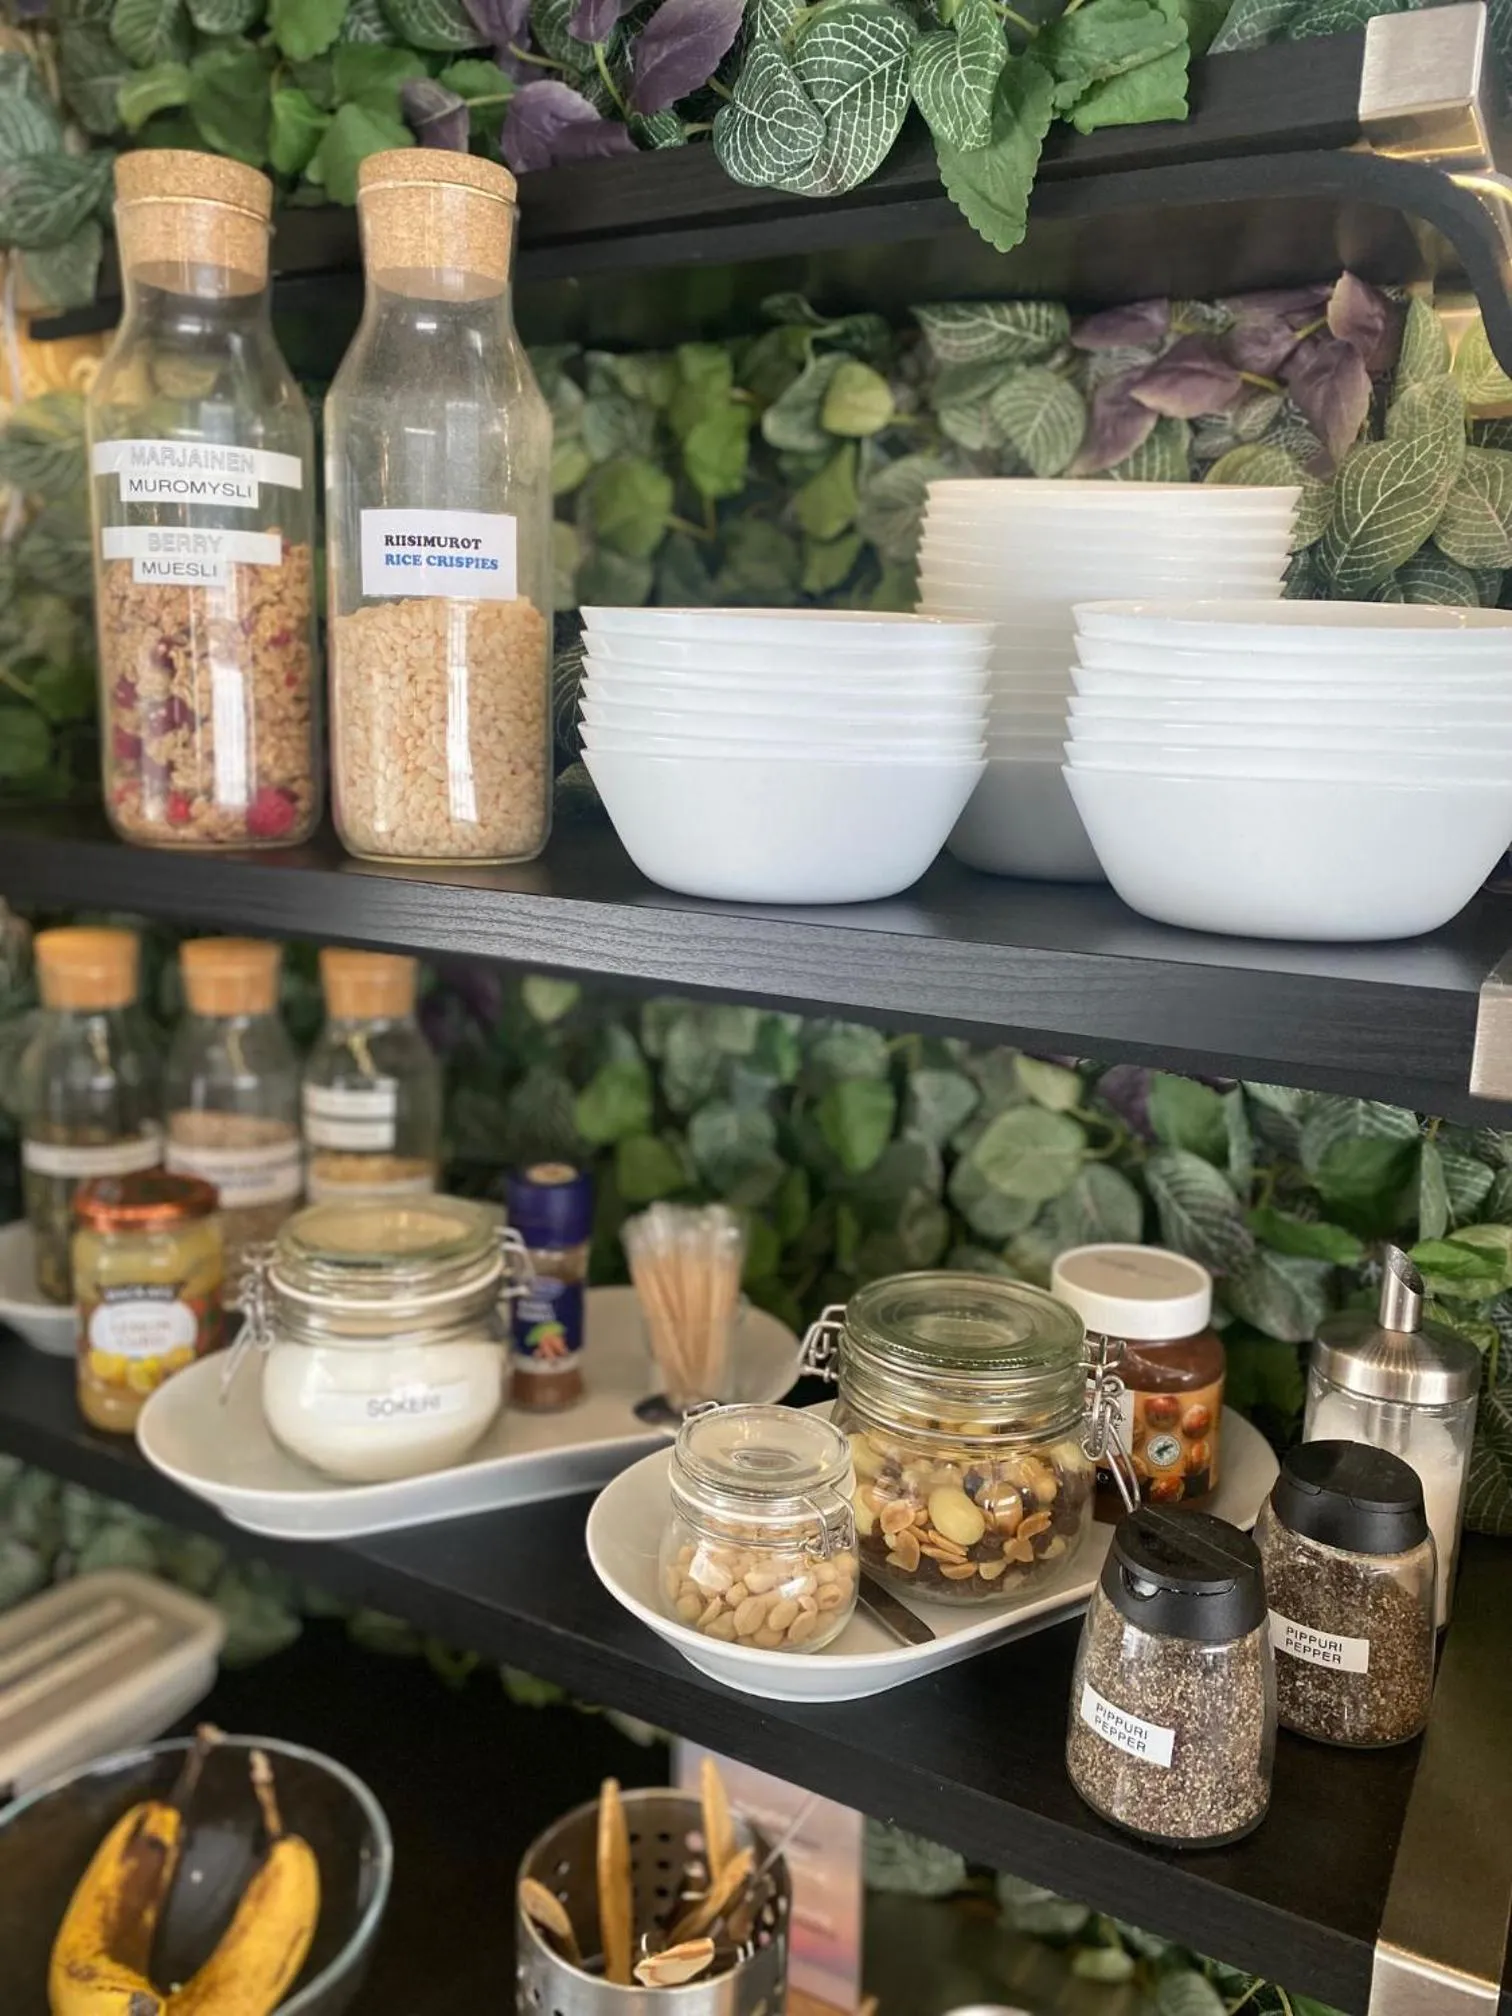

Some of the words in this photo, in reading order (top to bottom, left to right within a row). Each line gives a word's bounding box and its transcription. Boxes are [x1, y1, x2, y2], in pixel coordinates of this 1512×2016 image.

[130, 446, 255, 473] MARJAINEN
[128, 478, 252, 498] MUROMYSLI
[148, 532, 223, 555] BERRY
[384, 535, 482, 550] RIISIMUROT
[141, 561, 217, 577] MUESLI
[385, 554, 422, 566] RICE
[426, 555, 499, 570] CRISPIES
[1285, 1638, 1342, 1664] PEPPER
[1286, 1626, 1343, 1652] PIPPURI
[1096, 1702, 1148, 1740] PIPPURI
[1094, 1715, 1146, 1753] PEPPER
